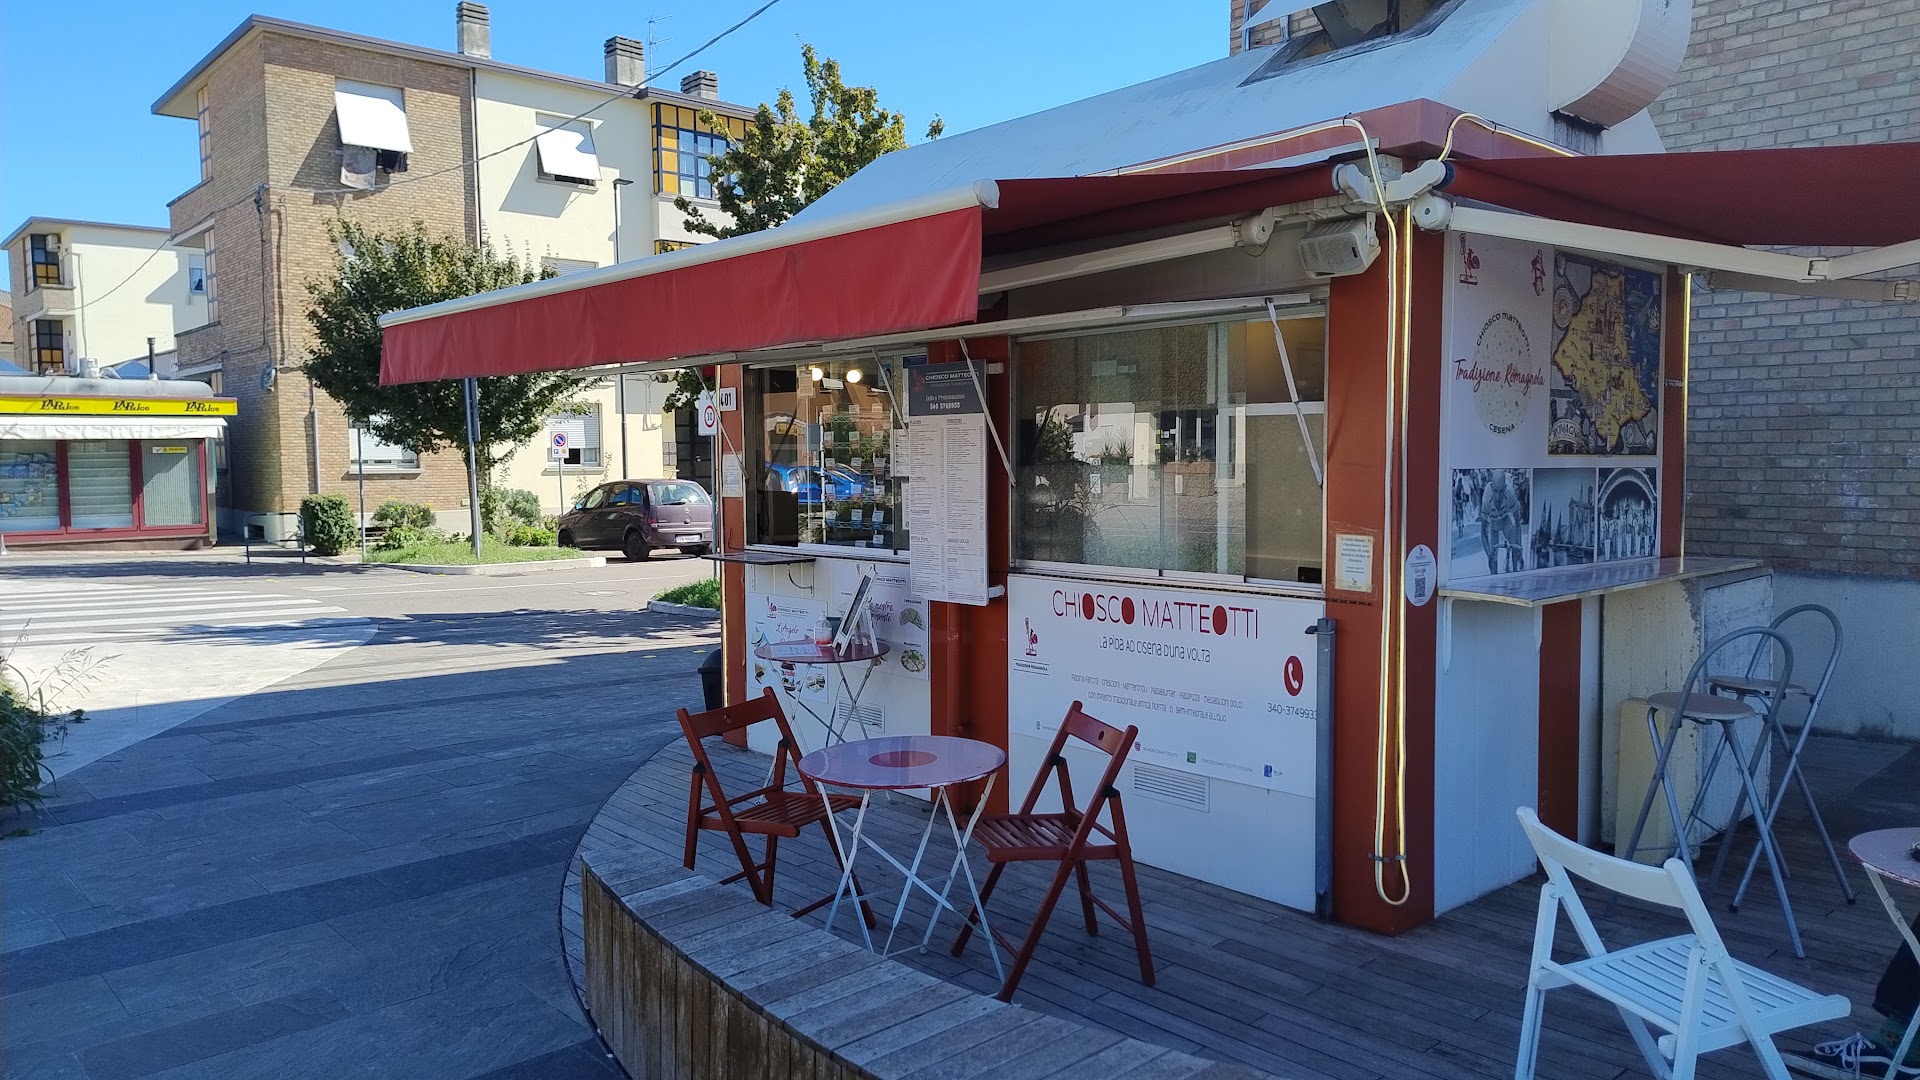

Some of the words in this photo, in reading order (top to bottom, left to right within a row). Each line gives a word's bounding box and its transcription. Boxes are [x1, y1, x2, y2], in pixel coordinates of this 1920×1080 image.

[1476, 313, 1501, 346] CHIOSCO
[1454, 358, 1502, 393] Tradizione
[1504, 362, 1545, 397] Romagnola
[1489, 423, 1515, 434] CESENA
[1052, 590, 1135, 625] CHIOSCO
[1142, 598, 1258, 640] MATTEOTTI
